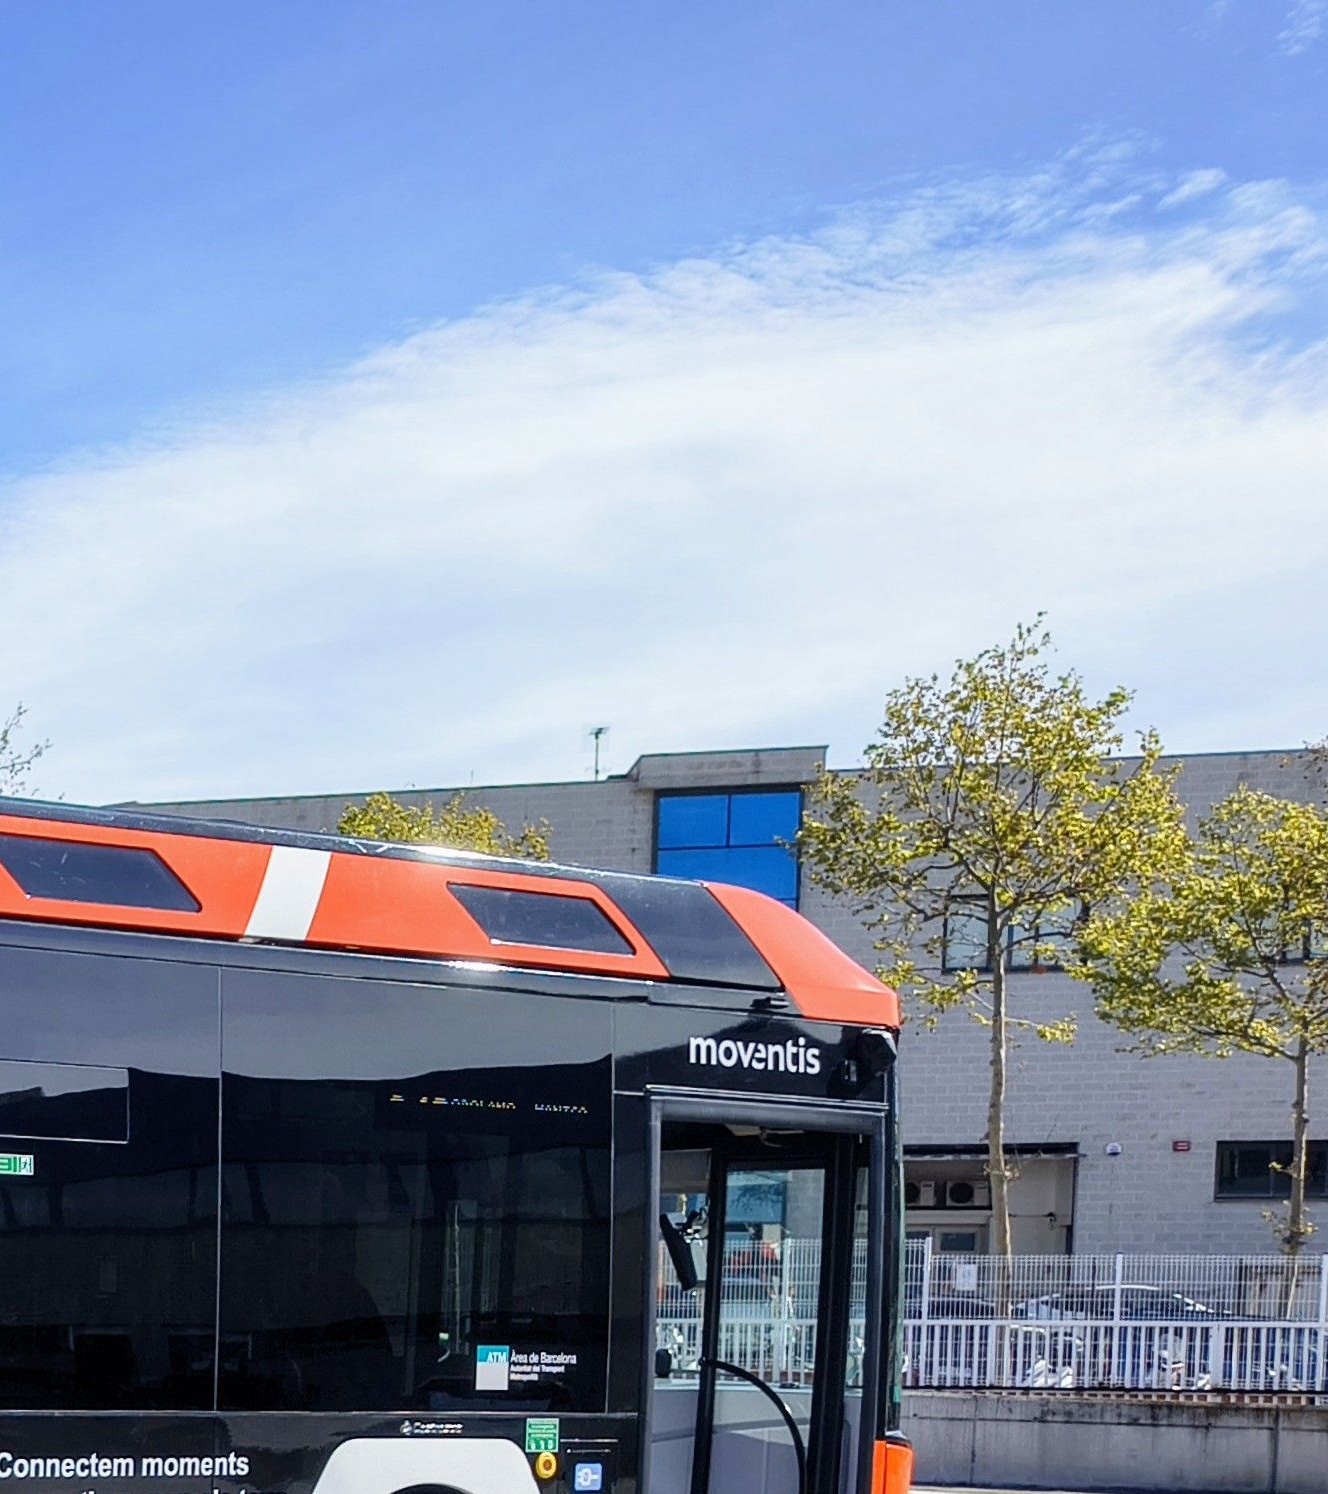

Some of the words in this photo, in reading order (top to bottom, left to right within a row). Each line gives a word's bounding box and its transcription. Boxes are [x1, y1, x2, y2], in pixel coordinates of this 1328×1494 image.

[688, 1034, 821, 1076] moventis
[529, 1352, 539, 1363] de
[540, 1351, 577, 1364] Barcelona
[141, 1450, 250, 1478] moments
